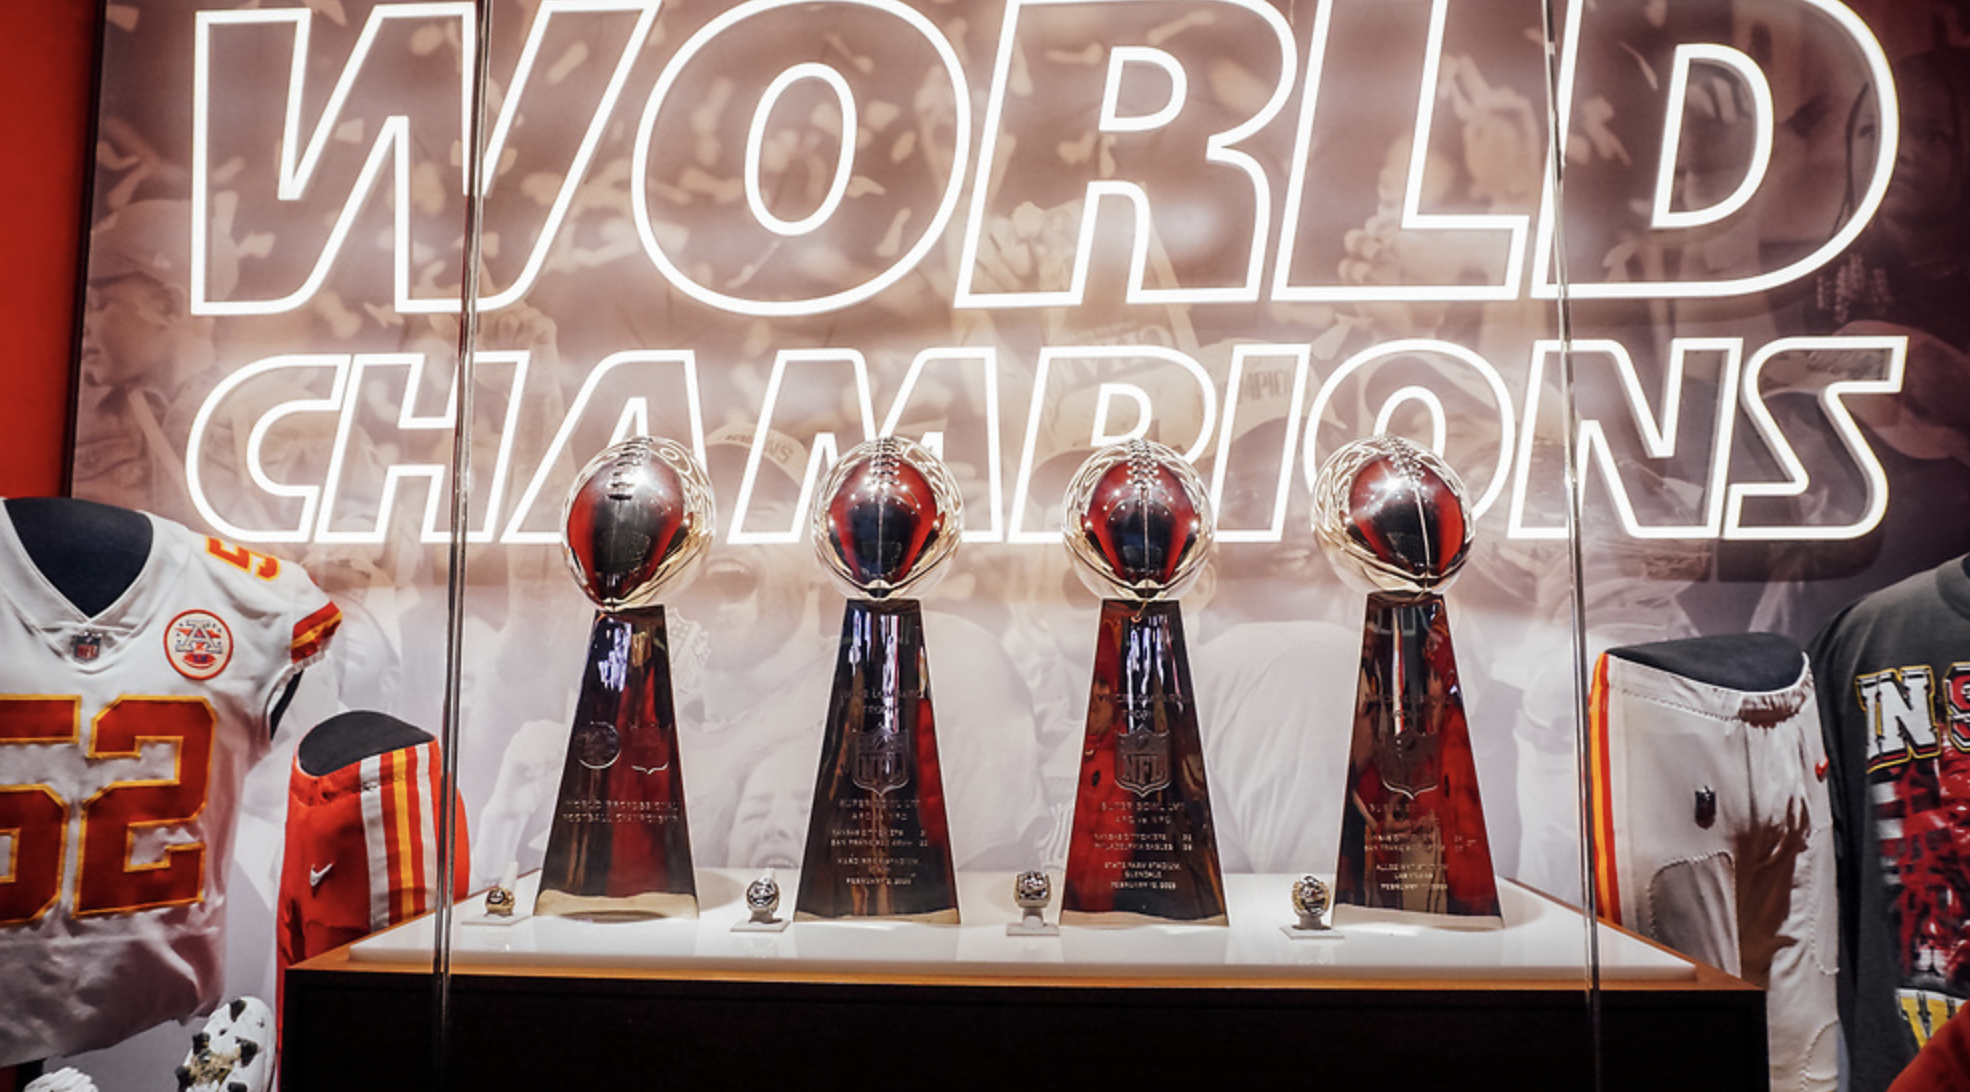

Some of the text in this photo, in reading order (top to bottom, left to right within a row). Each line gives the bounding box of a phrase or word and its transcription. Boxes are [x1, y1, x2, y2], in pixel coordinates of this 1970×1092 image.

[191, 0, 1900, 315] WORLD
[186, 335, 1909, 545] CHAMPIONS
[0, 693, 218, 926] 52
[1122, 753, 1167, 784] NFL
